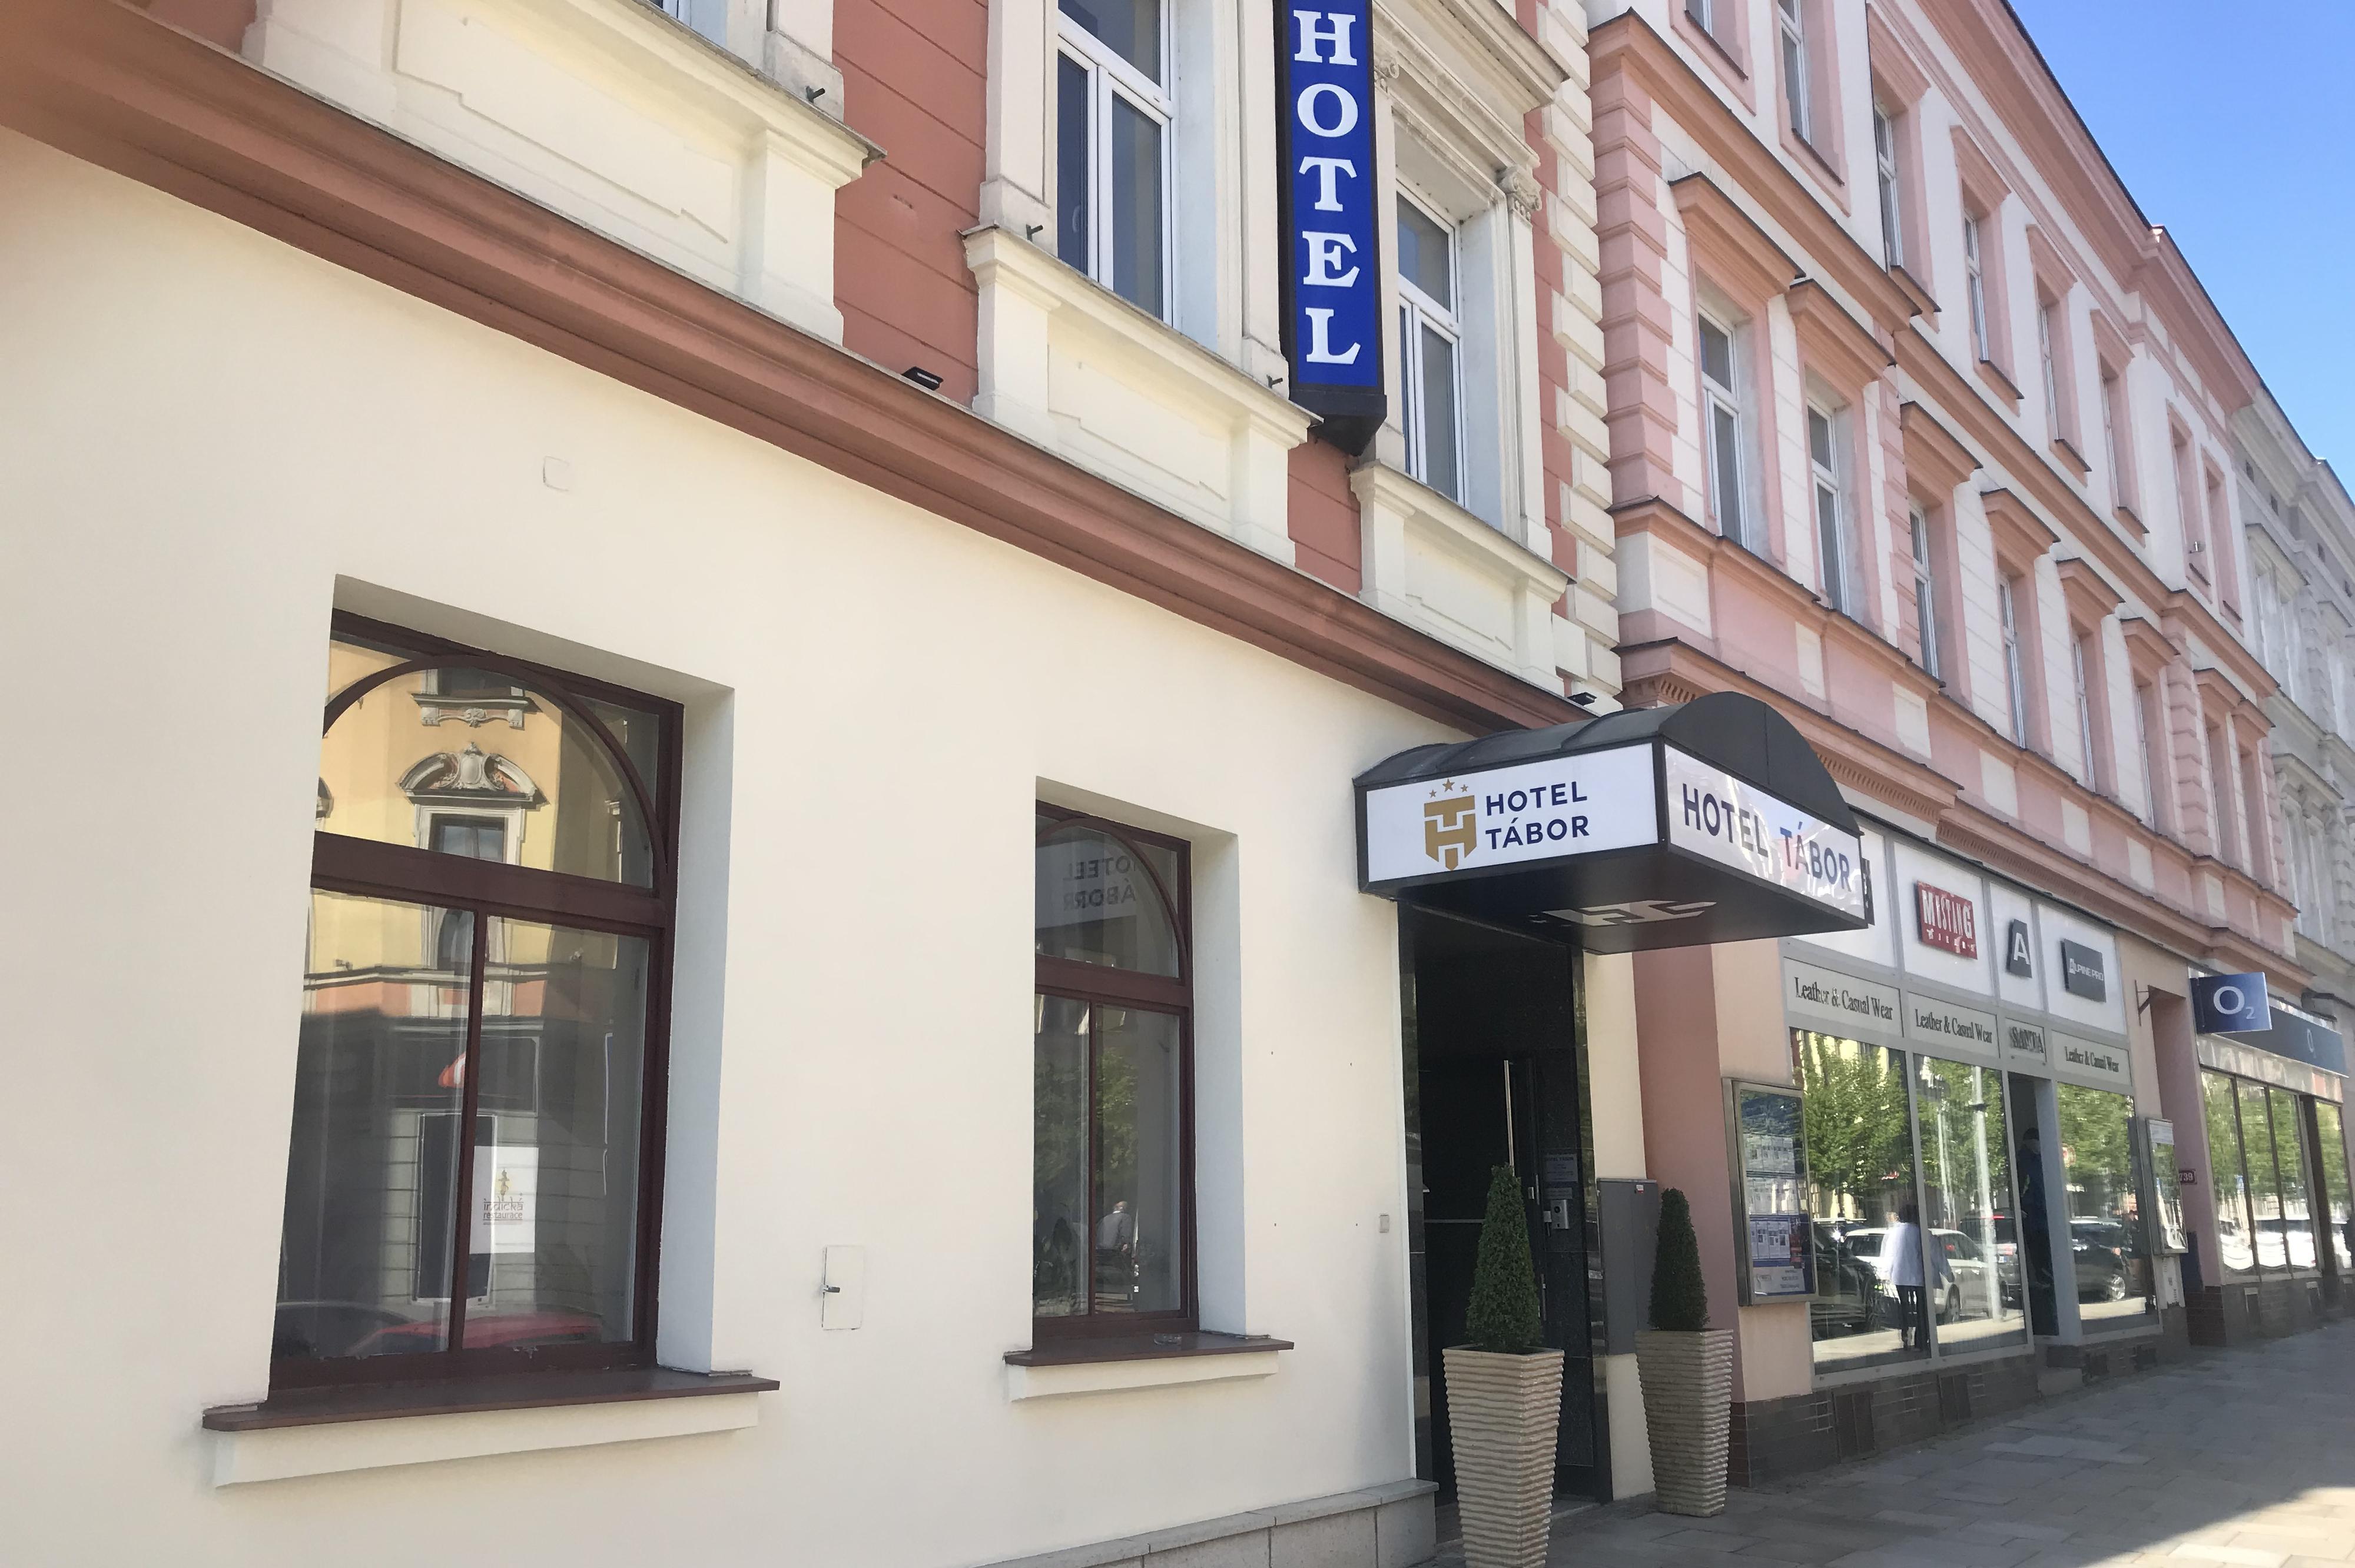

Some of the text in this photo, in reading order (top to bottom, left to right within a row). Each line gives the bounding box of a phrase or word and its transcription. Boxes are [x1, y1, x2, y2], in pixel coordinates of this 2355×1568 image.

[1293, 9, 1361, 365] HOTEL
[1485, 781, 1588, 816] HOTEL
[1485, 815, 1590, 850] TÁBOR
[1682, 783, 1769, 858] HOTEL
[1779, 821, 1852, 892] TÁBOR
[1921, 889, 1973, 939] MUSTANG
[2013, 932, 2031, 965] A
[2069, 958, 2104, 981] ALPINE PRO
[1794, 976, 1893, 1020] Leather & Casual Wear
[2213, 985, 2256, 1019] O2
[1915, 1008, 1992, 1044] Leather & Casual Wear
[2064, 1046, 2084, 1064] Leather
